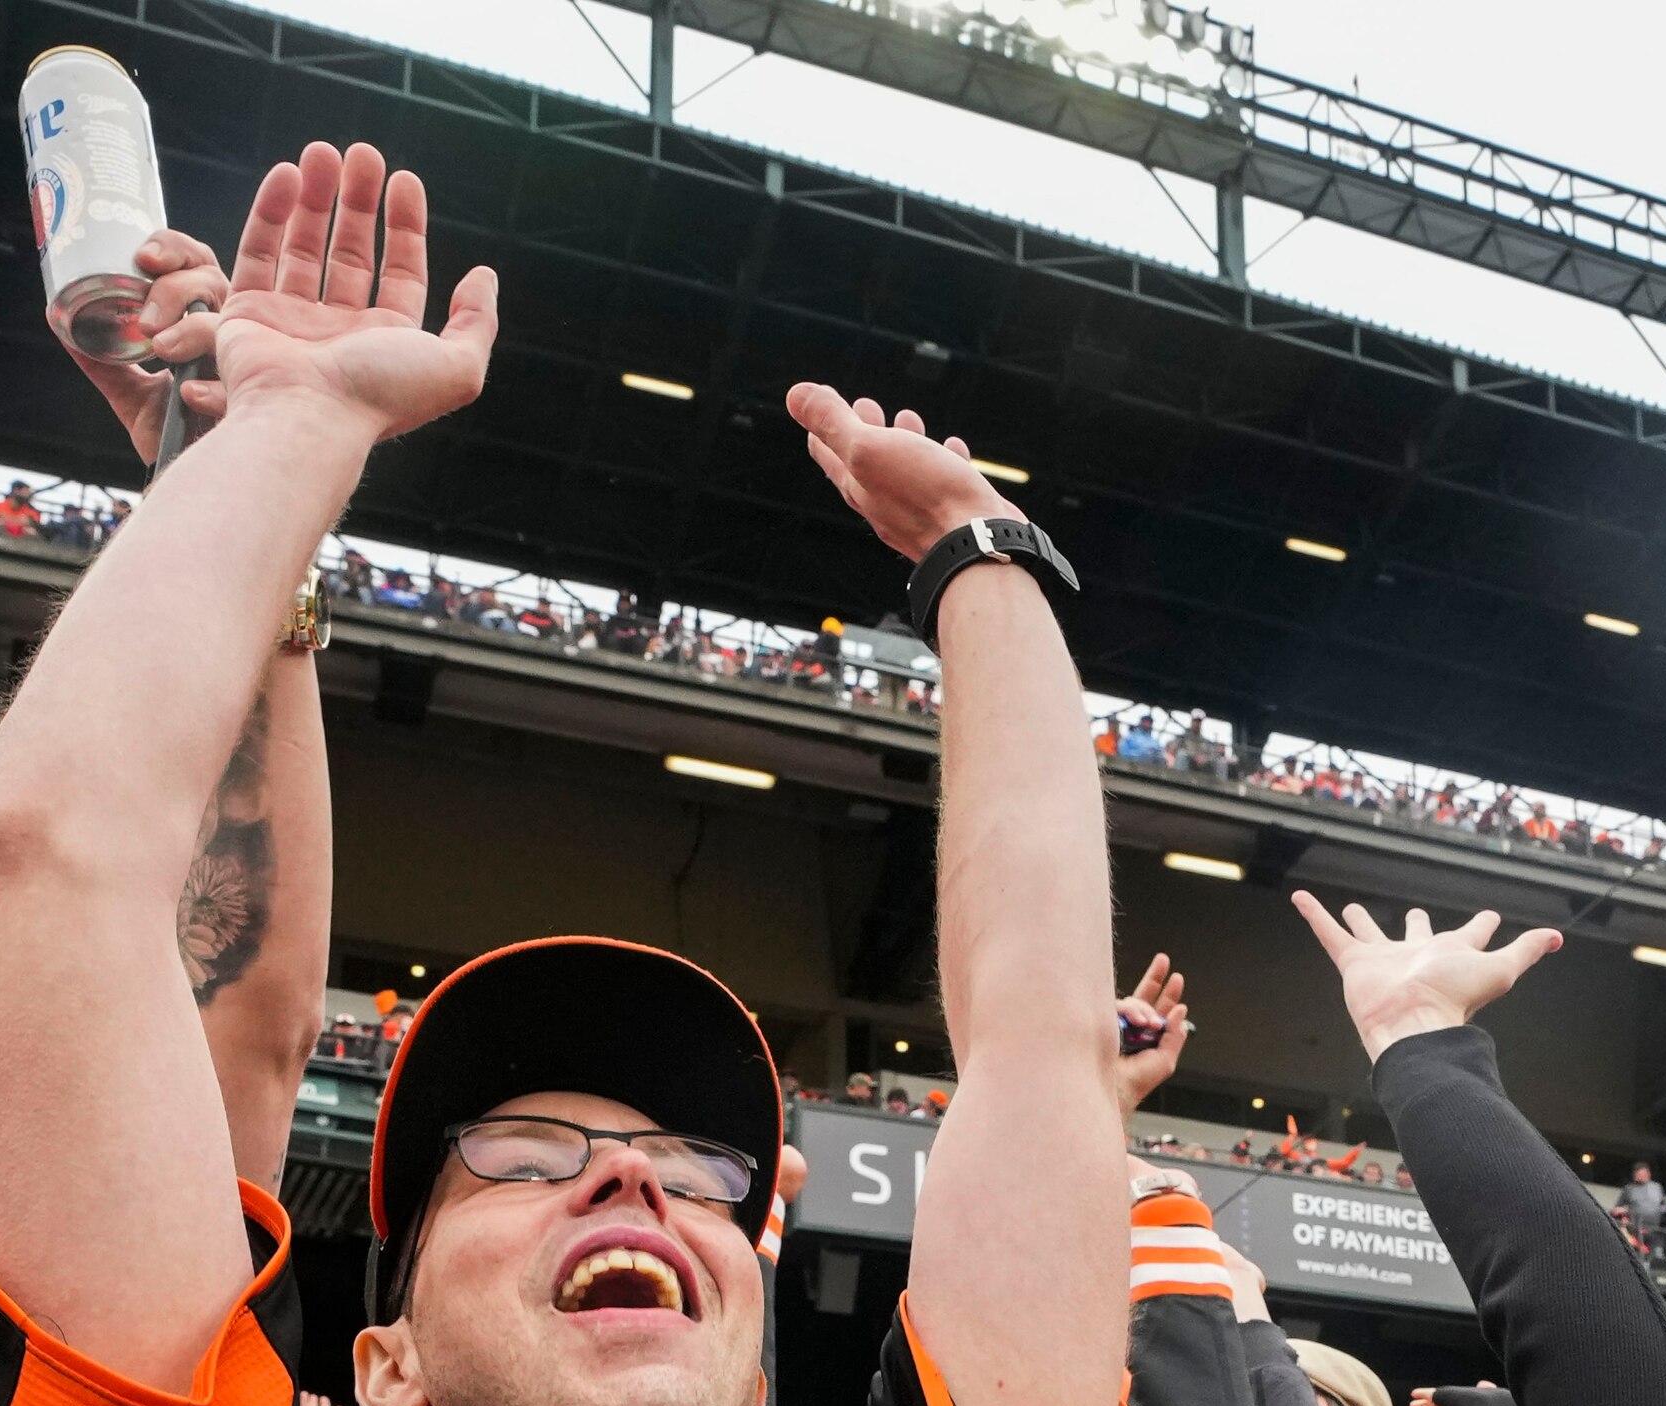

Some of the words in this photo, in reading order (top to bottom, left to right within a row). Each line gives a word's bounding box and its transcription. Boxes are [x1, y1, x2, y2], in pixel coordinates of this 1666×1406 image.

[1291, 1191, 1432, 1233] EXPERIENCE
[1292, 1222, 1328, 1247] OF
[1329, 1227, 1452, 1265] PAYMENTS
